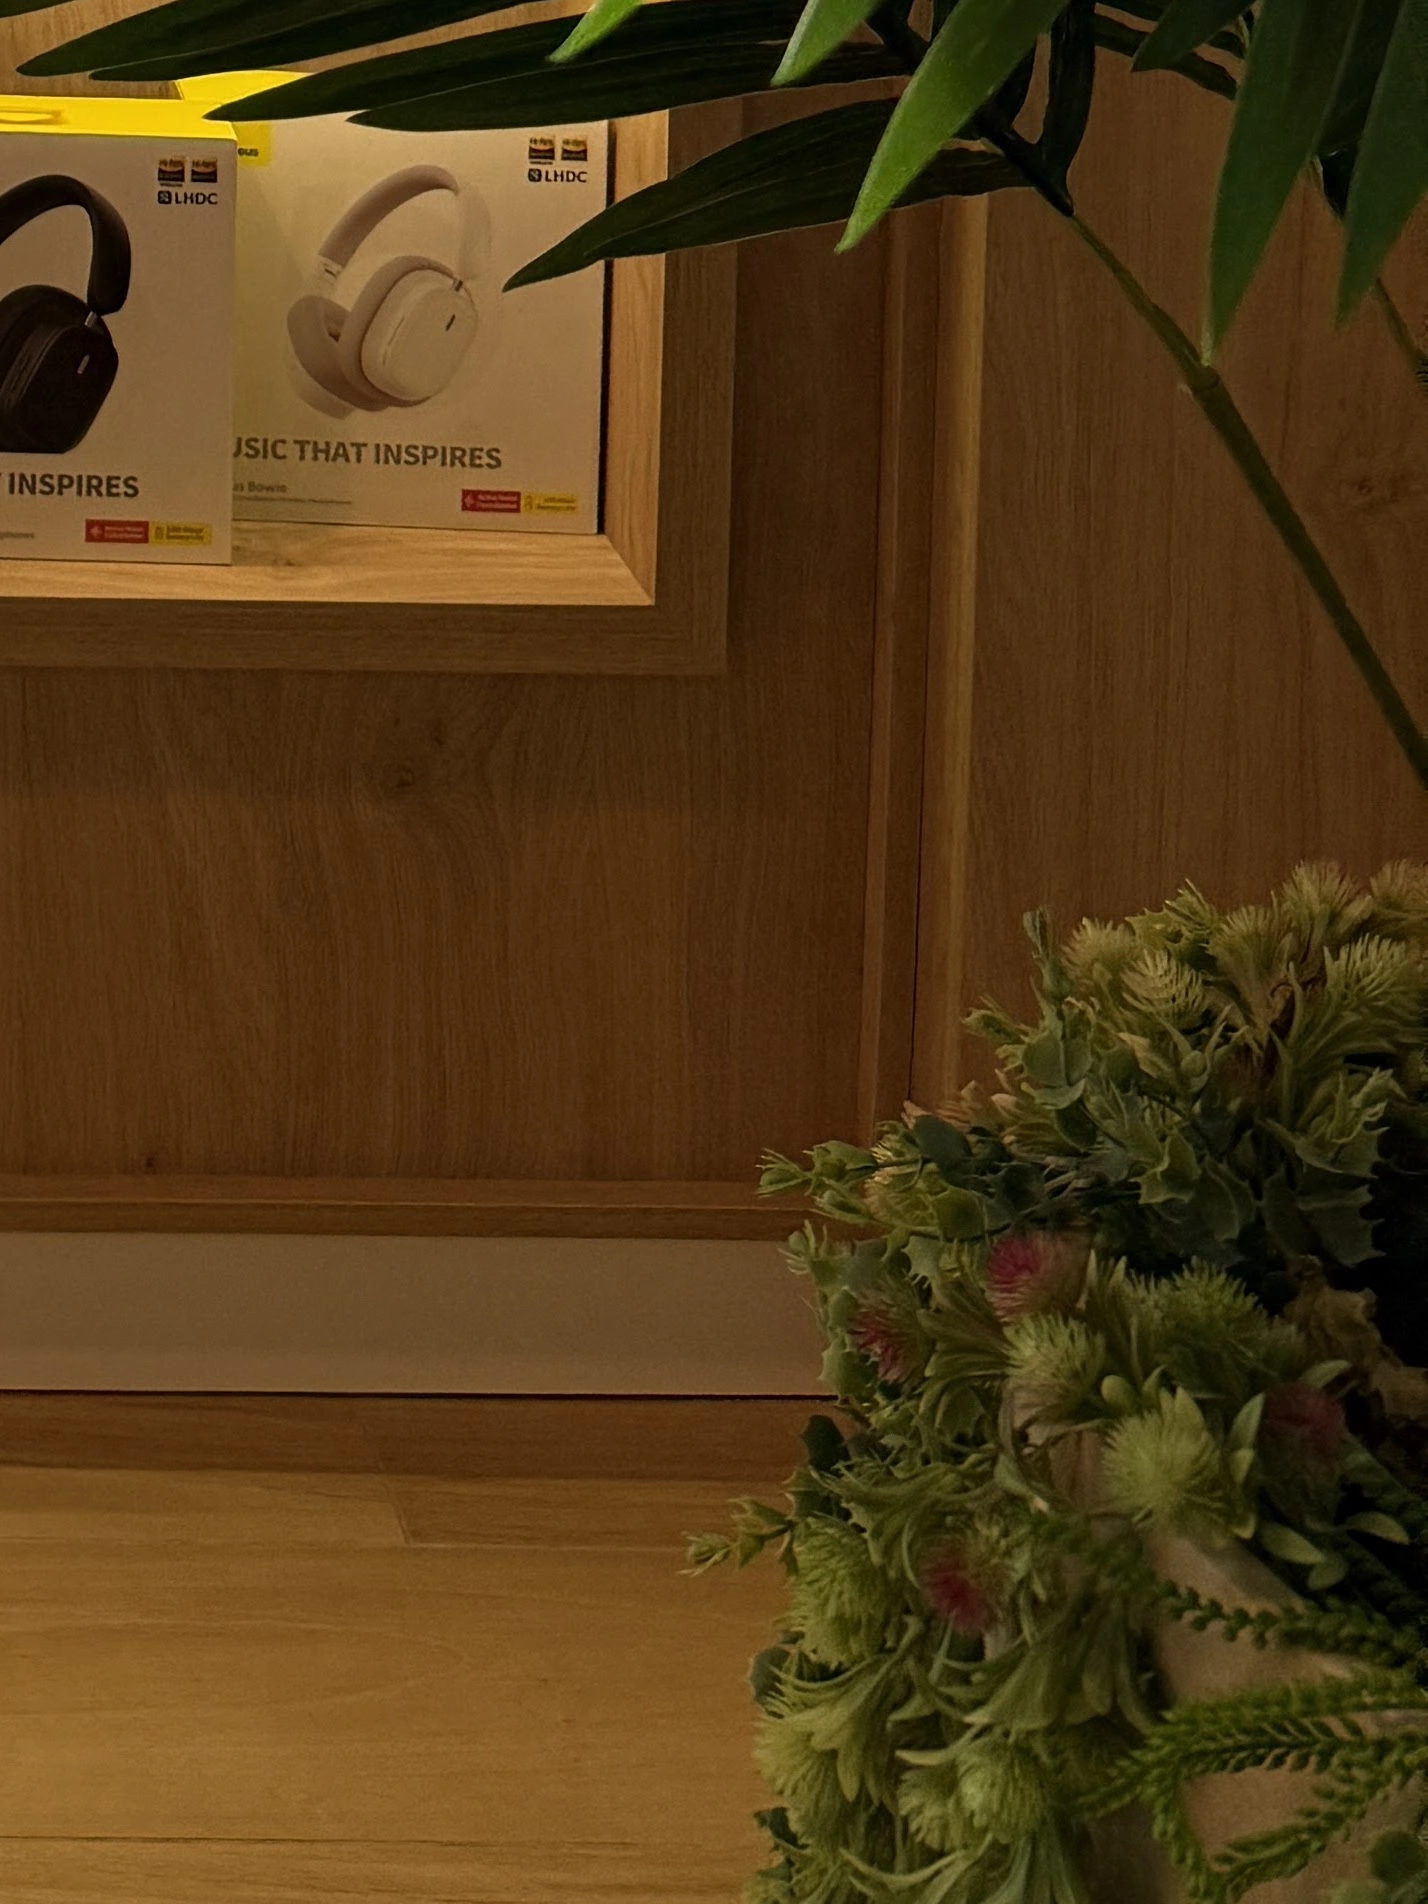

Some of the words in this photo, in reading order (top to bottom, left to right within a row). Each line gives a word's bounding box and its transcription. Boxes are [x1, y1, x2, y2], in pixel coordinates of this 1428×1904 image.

[545, 170, 588, 183] LHDC
[174, 192, 218, 205] LHDC
[233, 437, 288, 460] SIC
[293, 439, 368, 463] THAT
[374, 443, 503, 470] INSPIRES
[8, 472, 140, 498] INSPIRES
